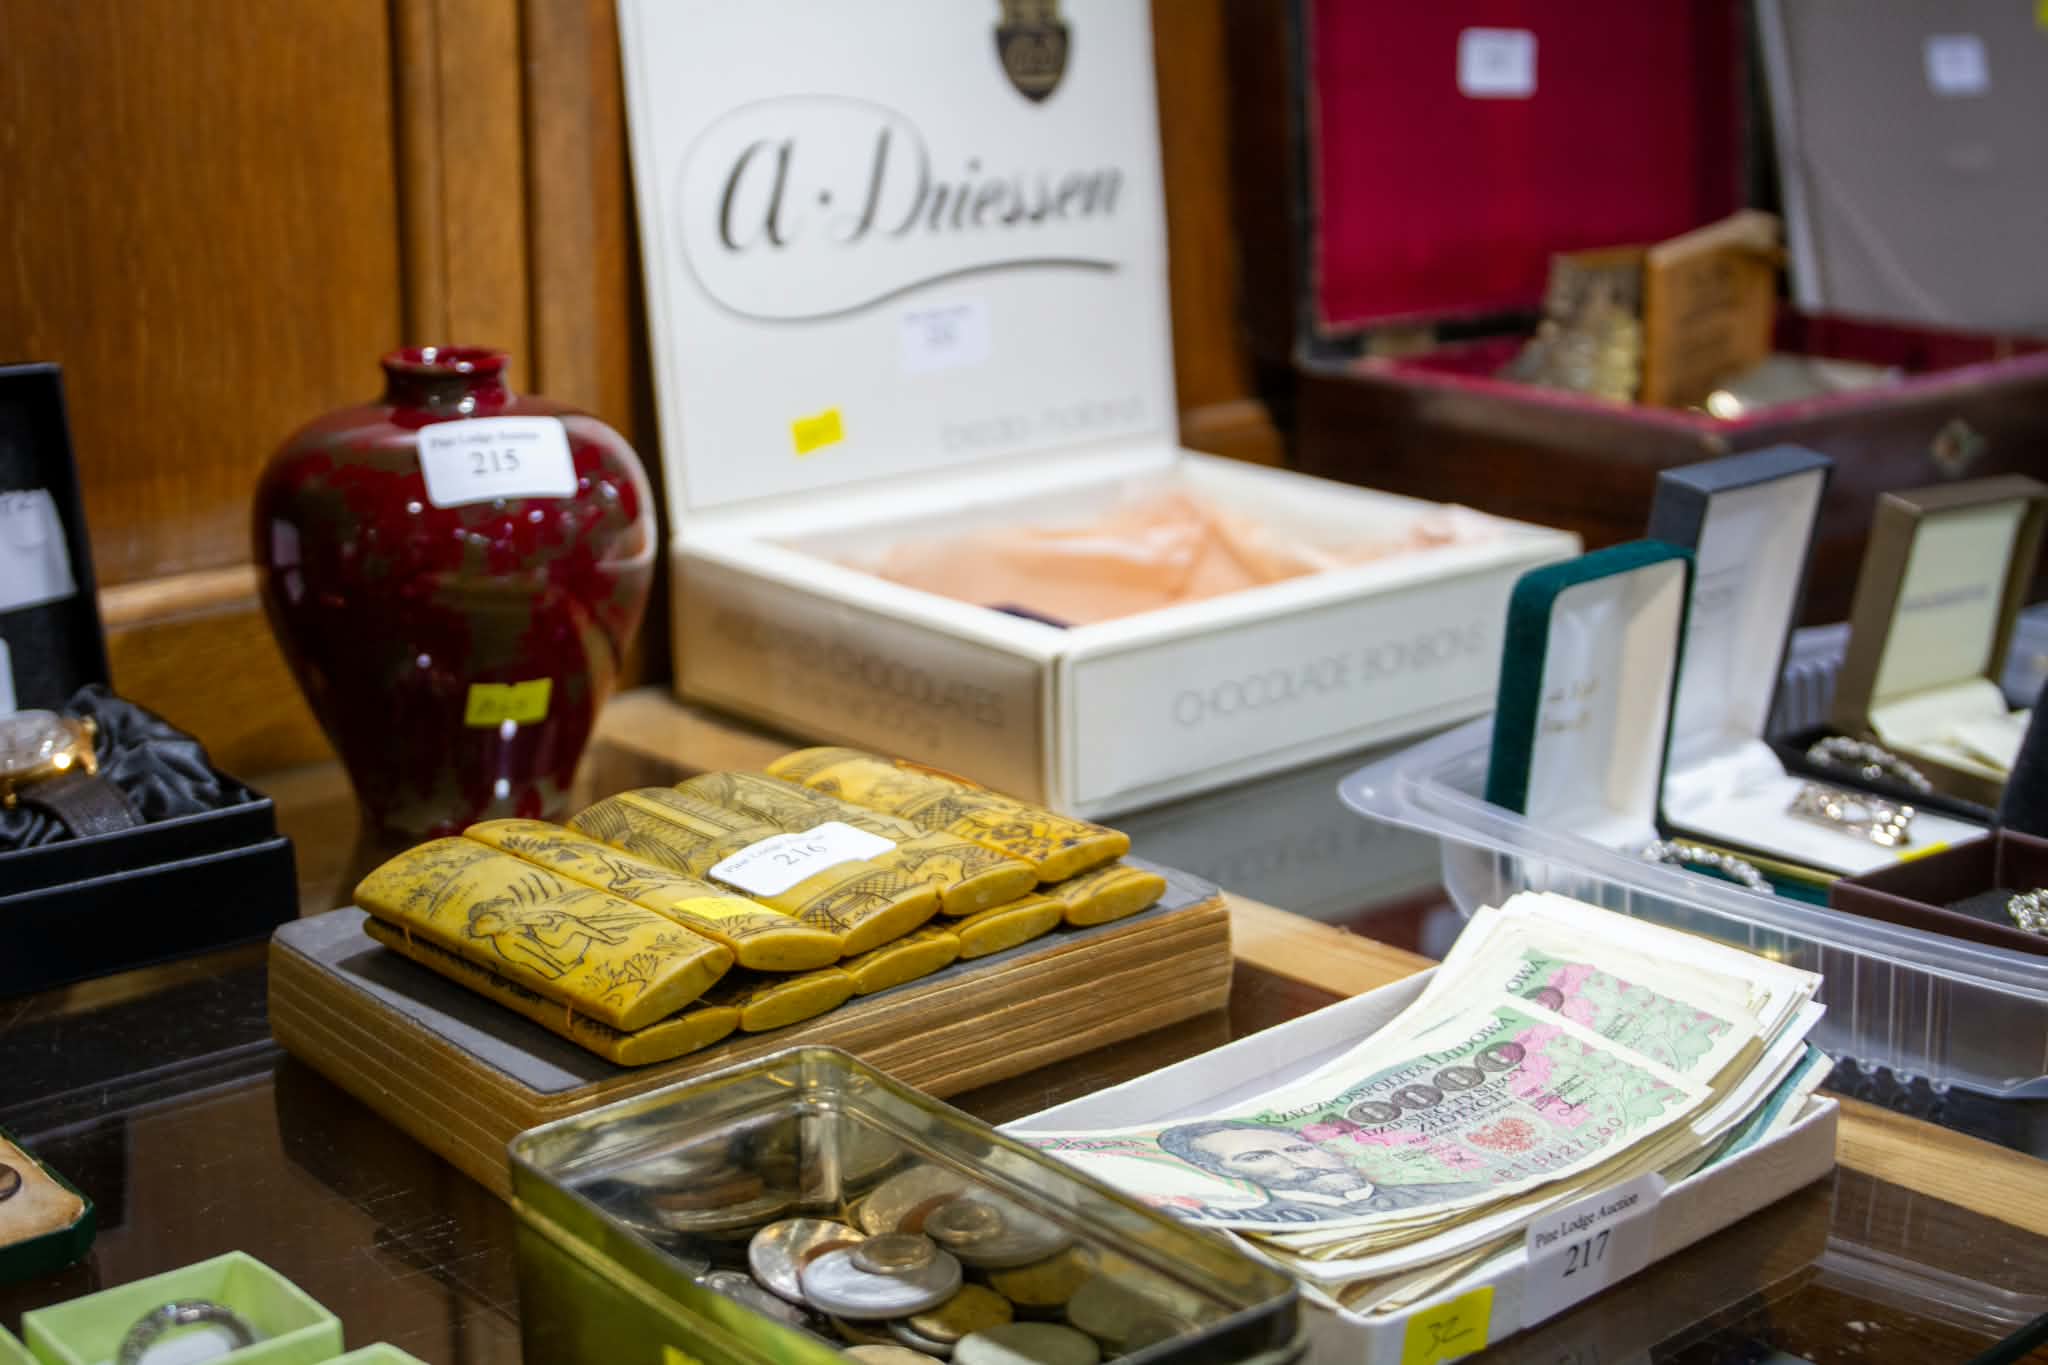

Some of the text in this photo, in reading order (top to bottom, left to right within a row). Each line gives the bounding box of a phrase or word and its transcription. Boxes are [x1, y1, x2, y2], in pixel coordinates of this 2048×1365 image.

[838, 125, 1125, 246] Driessen
[471, 448, 520, 475] 215
[773, 843, 827, 866] 216
[1535, 1192, 1639, 1248] Pine Lodge Auction
[1562, 1227, 1612, 1278] 217
